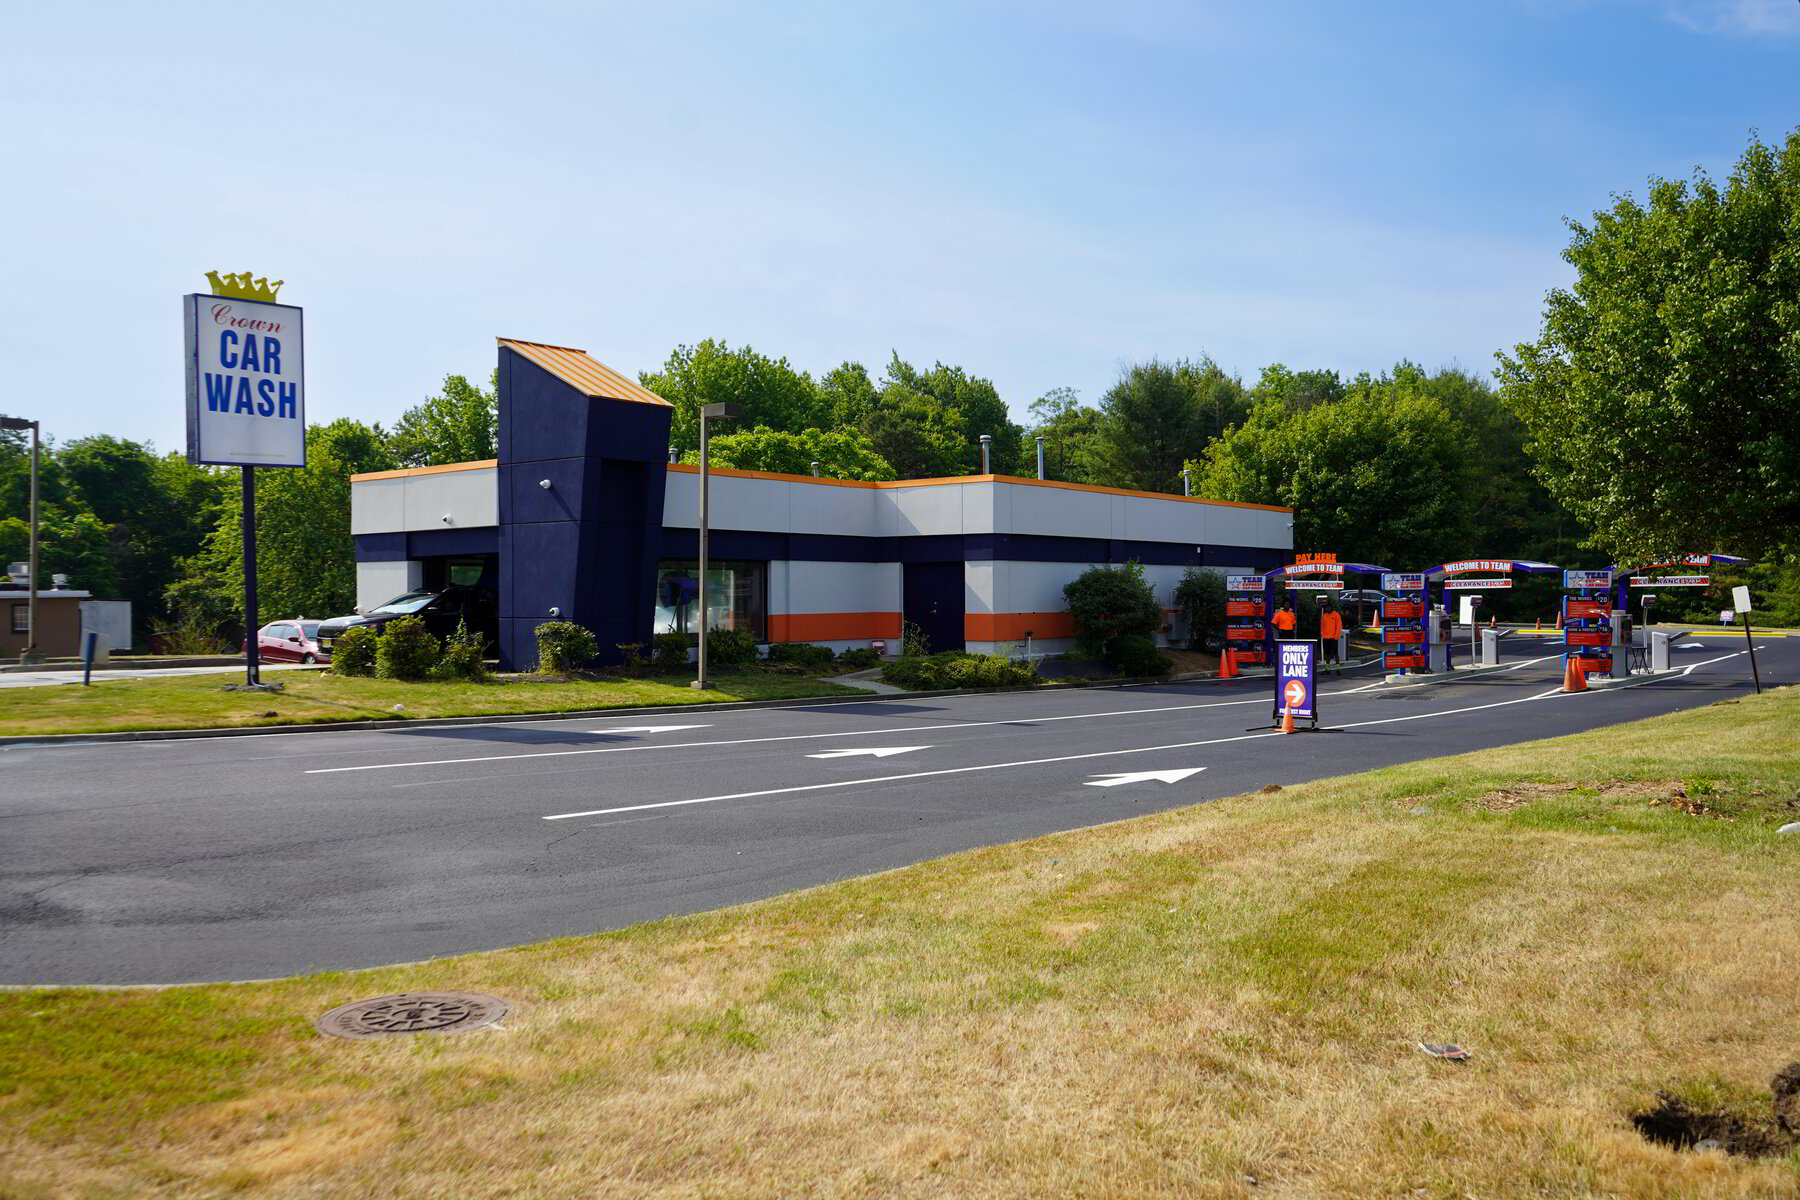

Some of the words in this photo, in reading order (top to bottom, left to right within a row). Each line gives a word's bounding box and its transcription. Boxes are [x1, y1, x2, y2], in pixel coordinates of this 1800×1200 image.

[211, 303, 286, 333] Crown
[220, 330, 281, 375] CAR
[205, 373, 297, 419] WASH
[1296, 554, 1312, 562] PAY
[1315, 553, 1337, 561] HERE
[1286, 564, 1316, 574] WELCOME
[1326, 564, 1343, 572] TEAM
[1445, 562, 1480, 572] WELCOME
[1480, 562, 1489, 570] TO
[1491, 562, 1510, 571] TEAM
[1283, 653, 1308, 664] ONLY
[1283, 665, 1308, 677] LANE
